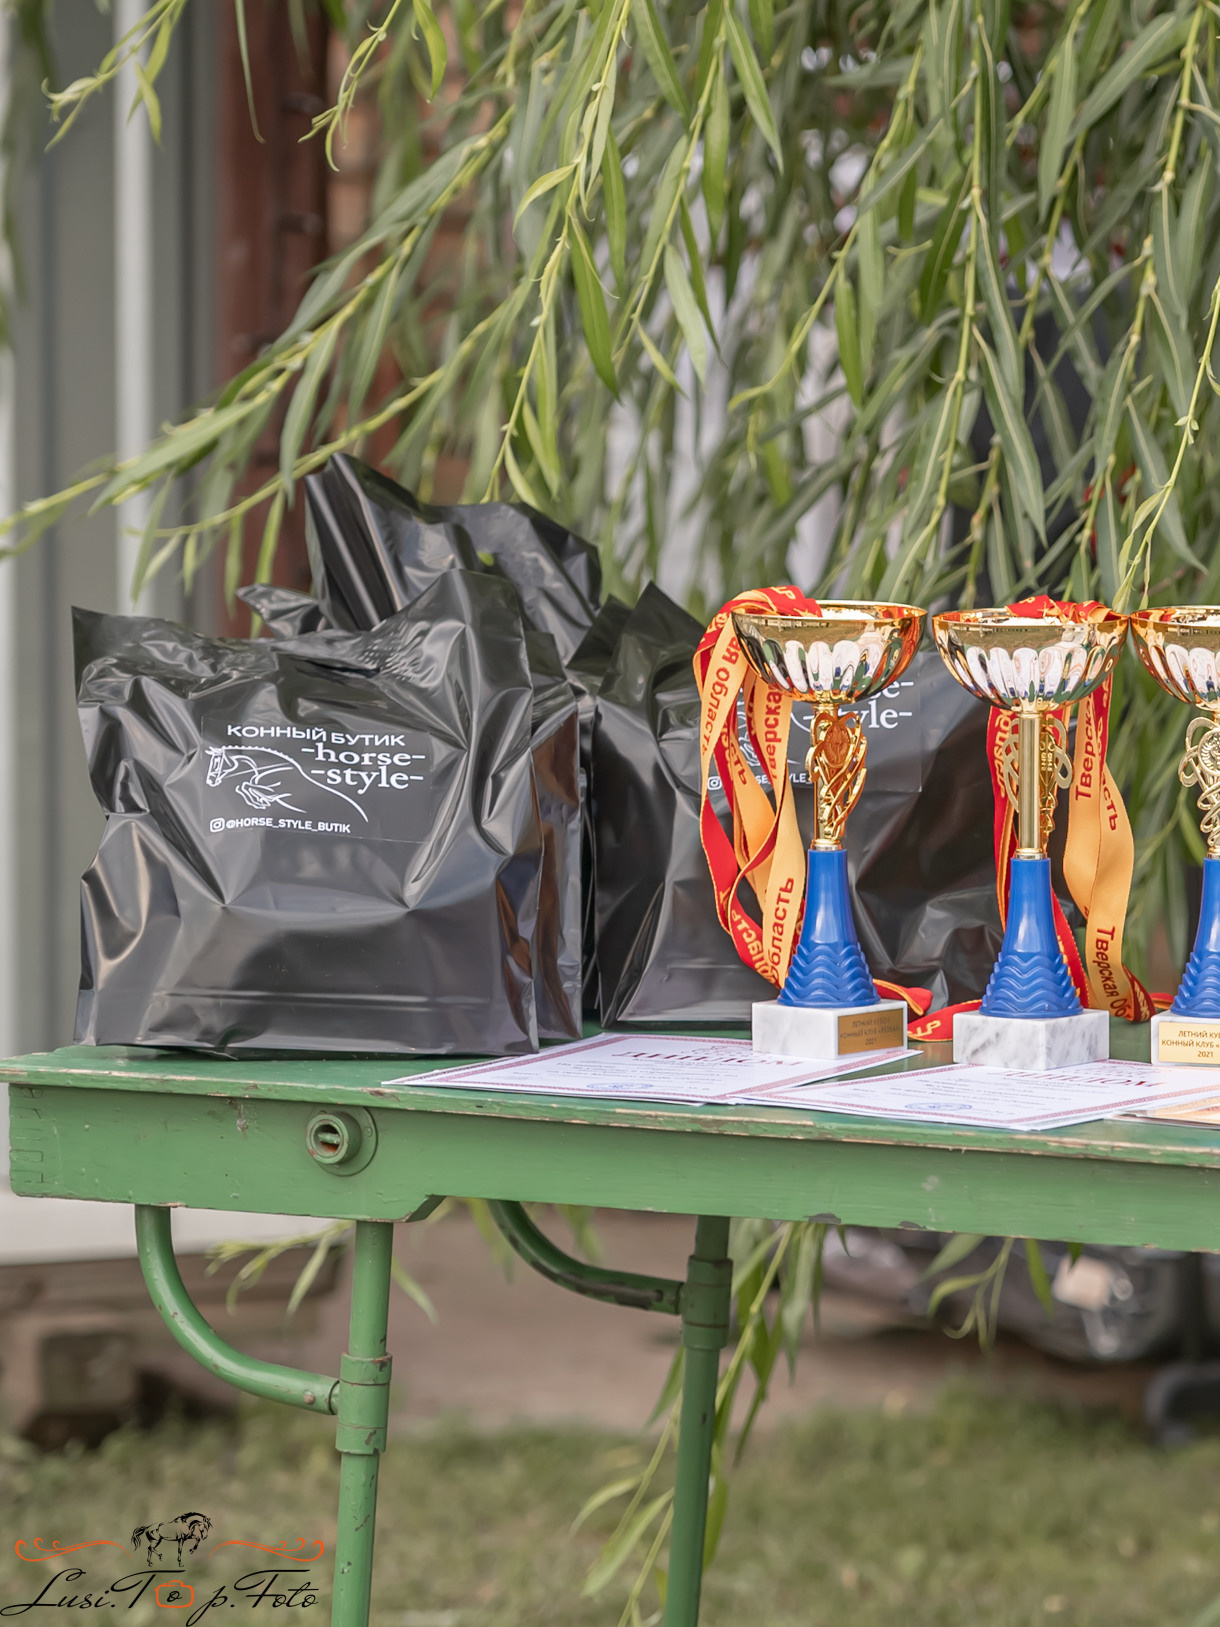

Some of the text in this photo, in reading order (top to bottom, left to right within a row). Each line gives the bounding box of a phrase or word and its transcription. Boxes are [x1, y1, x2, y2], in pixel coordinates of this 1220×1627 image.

[227, 725, 406, 747] КОННЫЙ БУТИК
[226, 817, 351, 833] @HORSE_STYLE_BUTIK
[1178, 1030, 1208, 1038] ЛЕТНИЙ
[1161, 1039, 1194, 1047] КОННЫЙ
[1195, 1041, 1214, 1049] КЛУБ
